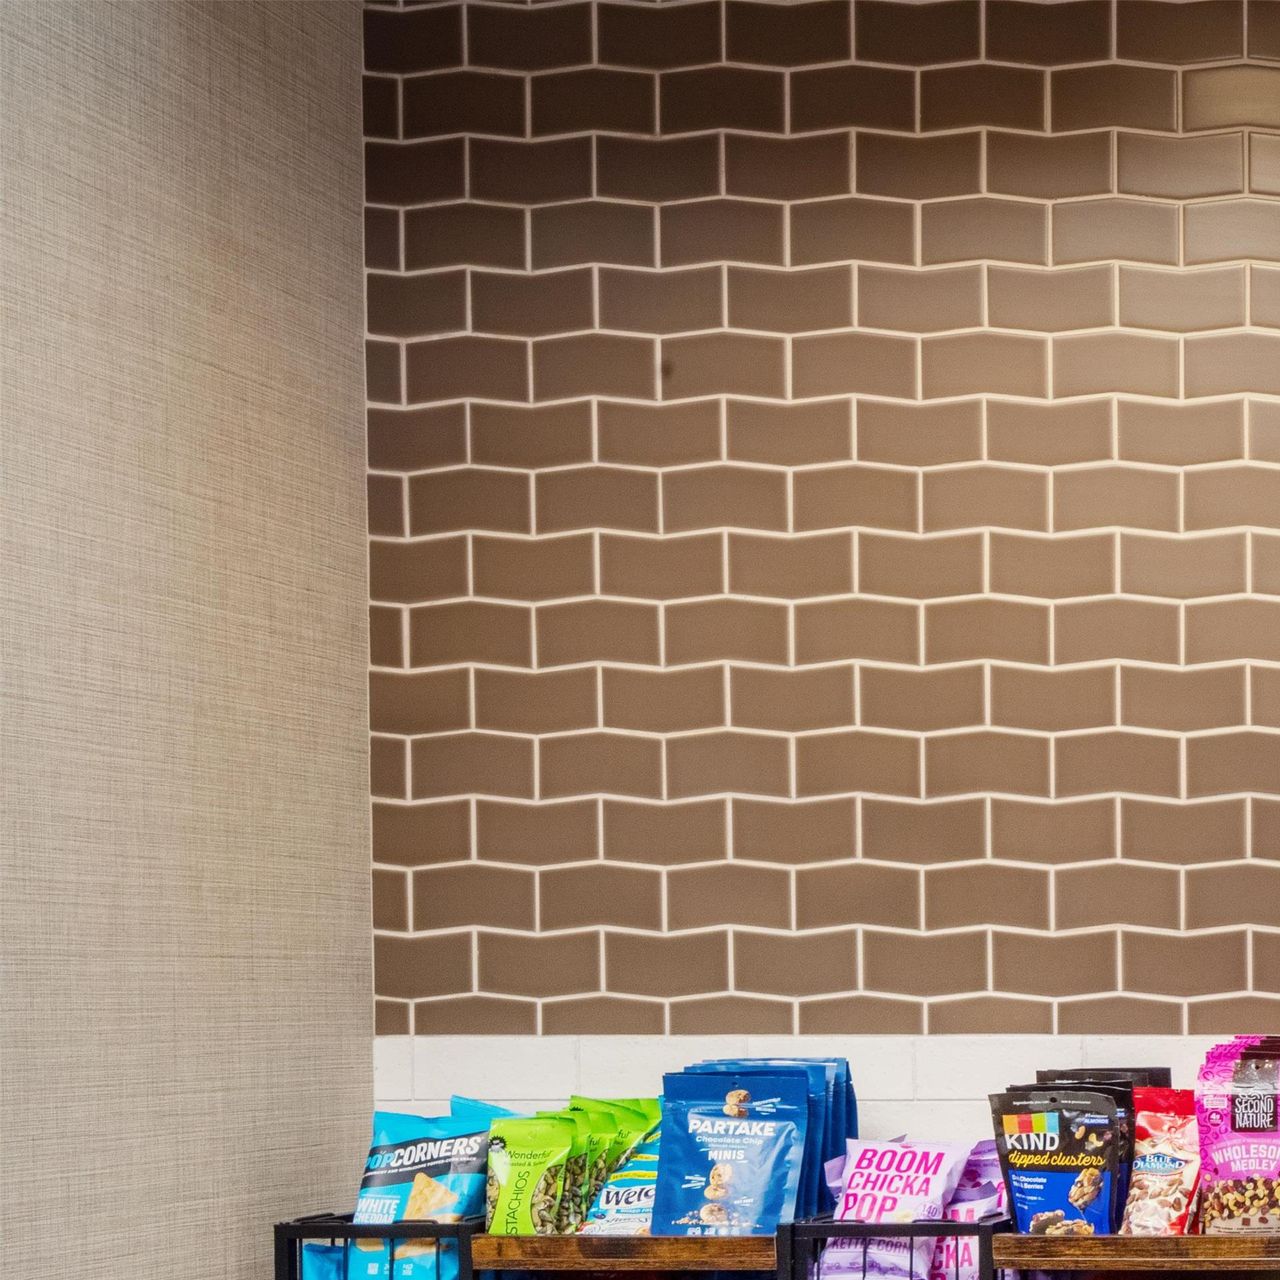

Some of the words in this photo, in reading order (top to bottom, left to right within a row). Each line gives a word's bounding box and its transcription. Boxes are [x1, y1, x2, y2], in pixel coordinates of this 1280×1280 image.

[1235, 1097, 1273, 1113] SECOND
[688, 1119, 776, 1135] PARTAKE
[1235, 1112, 1274, 1128] NATURE
[696, 1135, 740, 1144] Chocolate
[742, 1136, 763, 1145] Chip
[1004, 1133, 1059, 1151] KIND
[708, 1149, 746, 1160] MINIS
[855, 1148, 945, 1176] BOOM
[1008, 1150, 1050, 1167] dipped
[1050, 1152, 1106, 1167] clusters
[1145, 1152, 1170, 1164] BLUE
[1133, 1160, 1186, 1172] DIAMOND
[1231, 1159, 1278, 1172] MEDLEY
[848, 1171, 931, 1197] CHICKA
[358, 1199, 398, 1212] WHITE
[840, 1192, 898, 1223] POP
